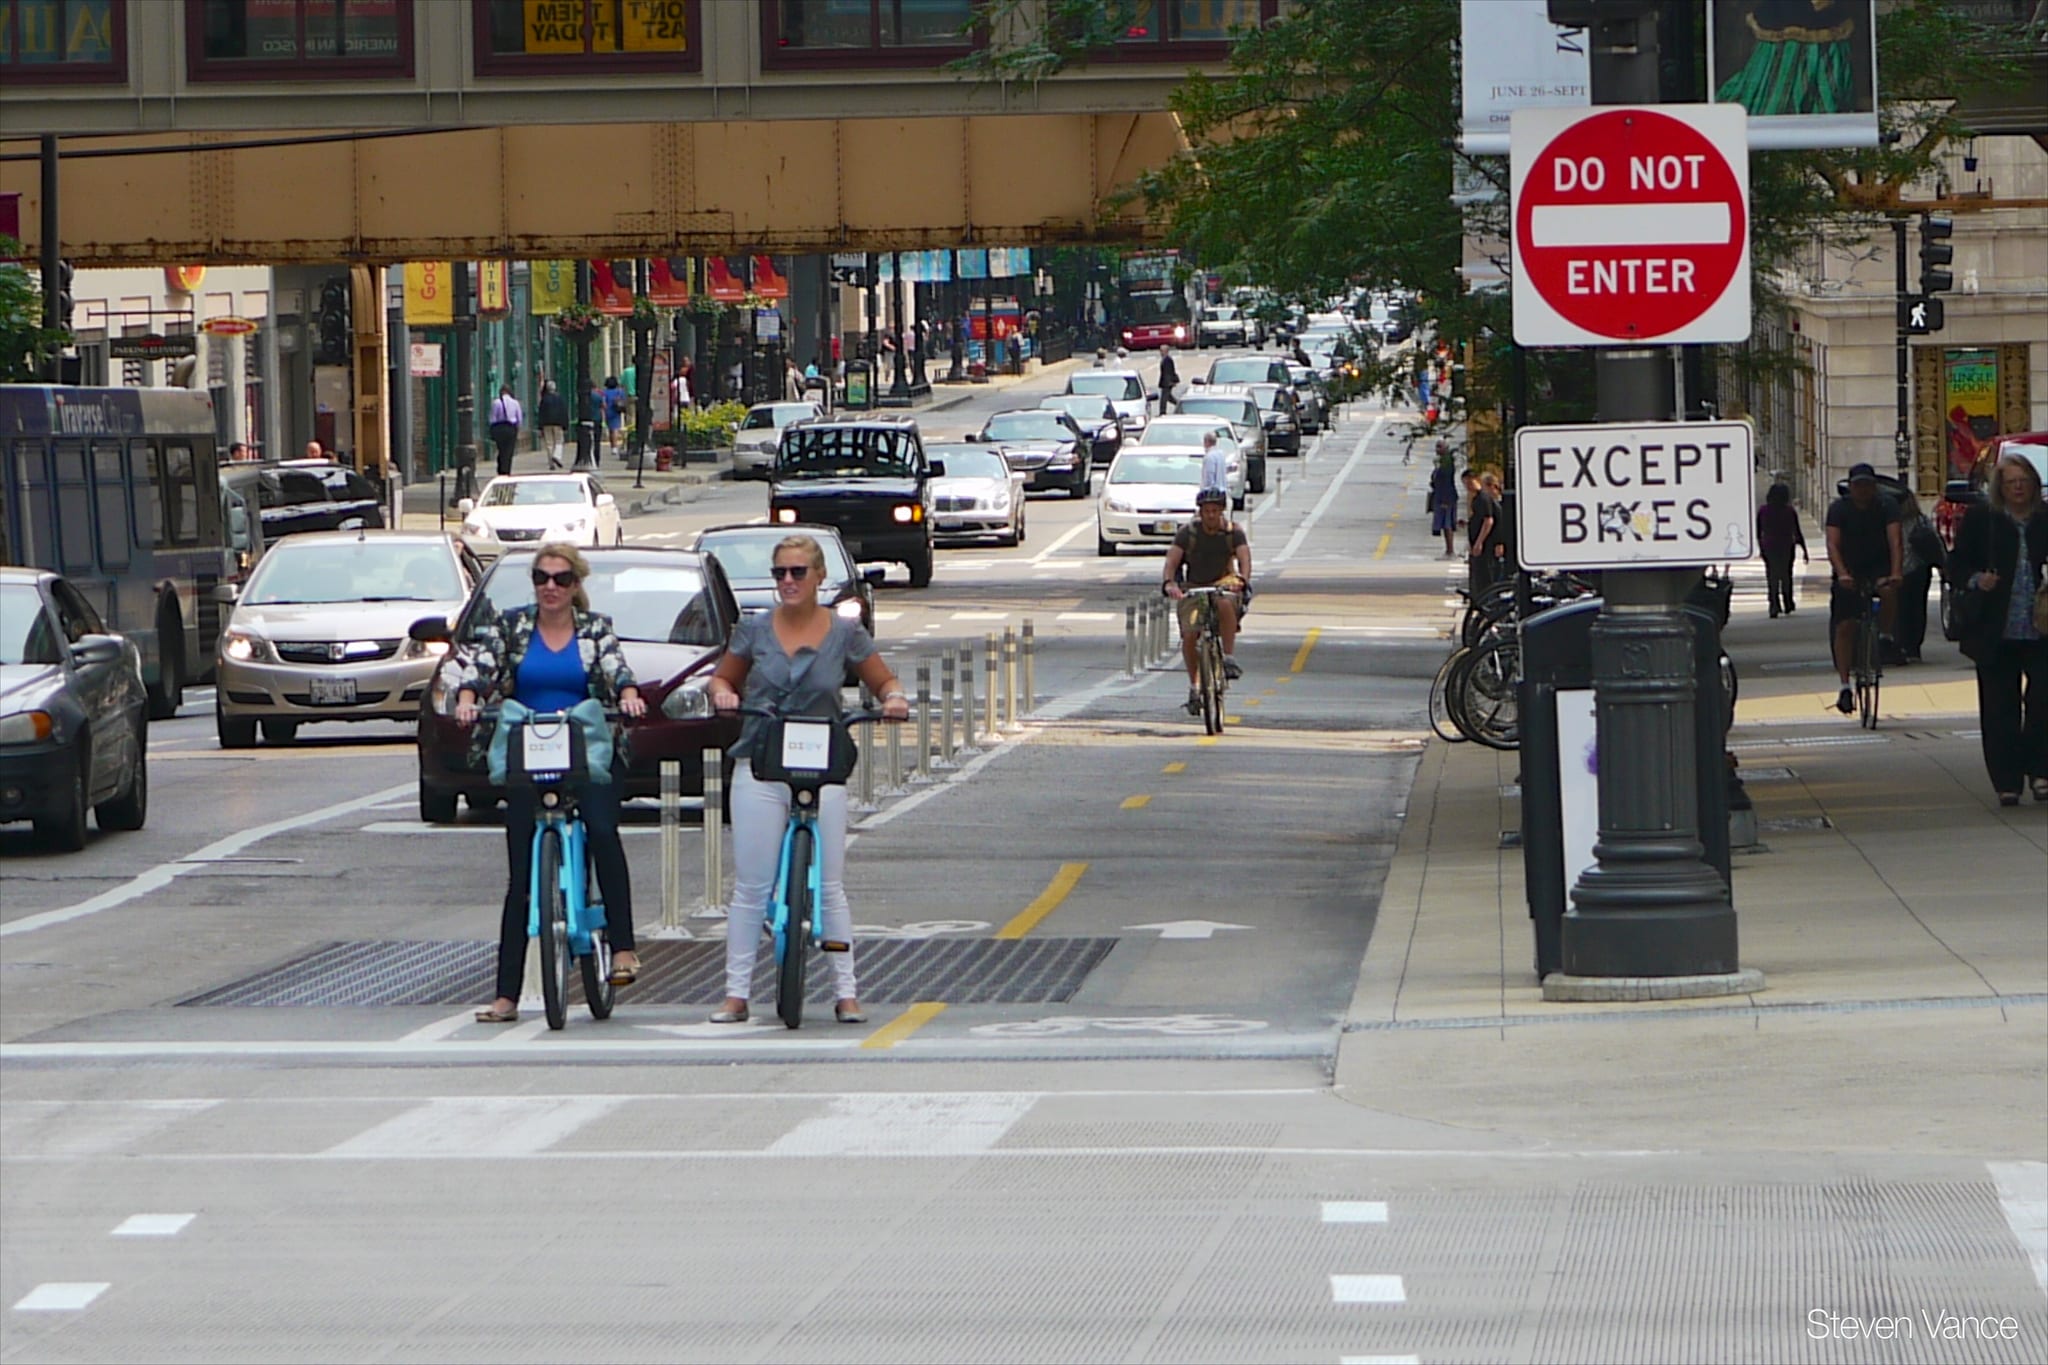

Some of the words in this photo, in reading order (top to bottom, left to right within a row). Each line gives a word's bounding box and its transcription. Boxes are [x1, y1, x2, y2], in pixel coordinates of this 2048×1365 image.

[1490, 85, 1527, 100] JUNE
[1554, 156, 1605, 192] DO
[1630, 154, 1706, 191] NOT
[1567, 258, 1696, 294] ENTER
[1953, 383, 1990, 392] BOOK
[1537, 443, 1730, 488] EXCEPT
